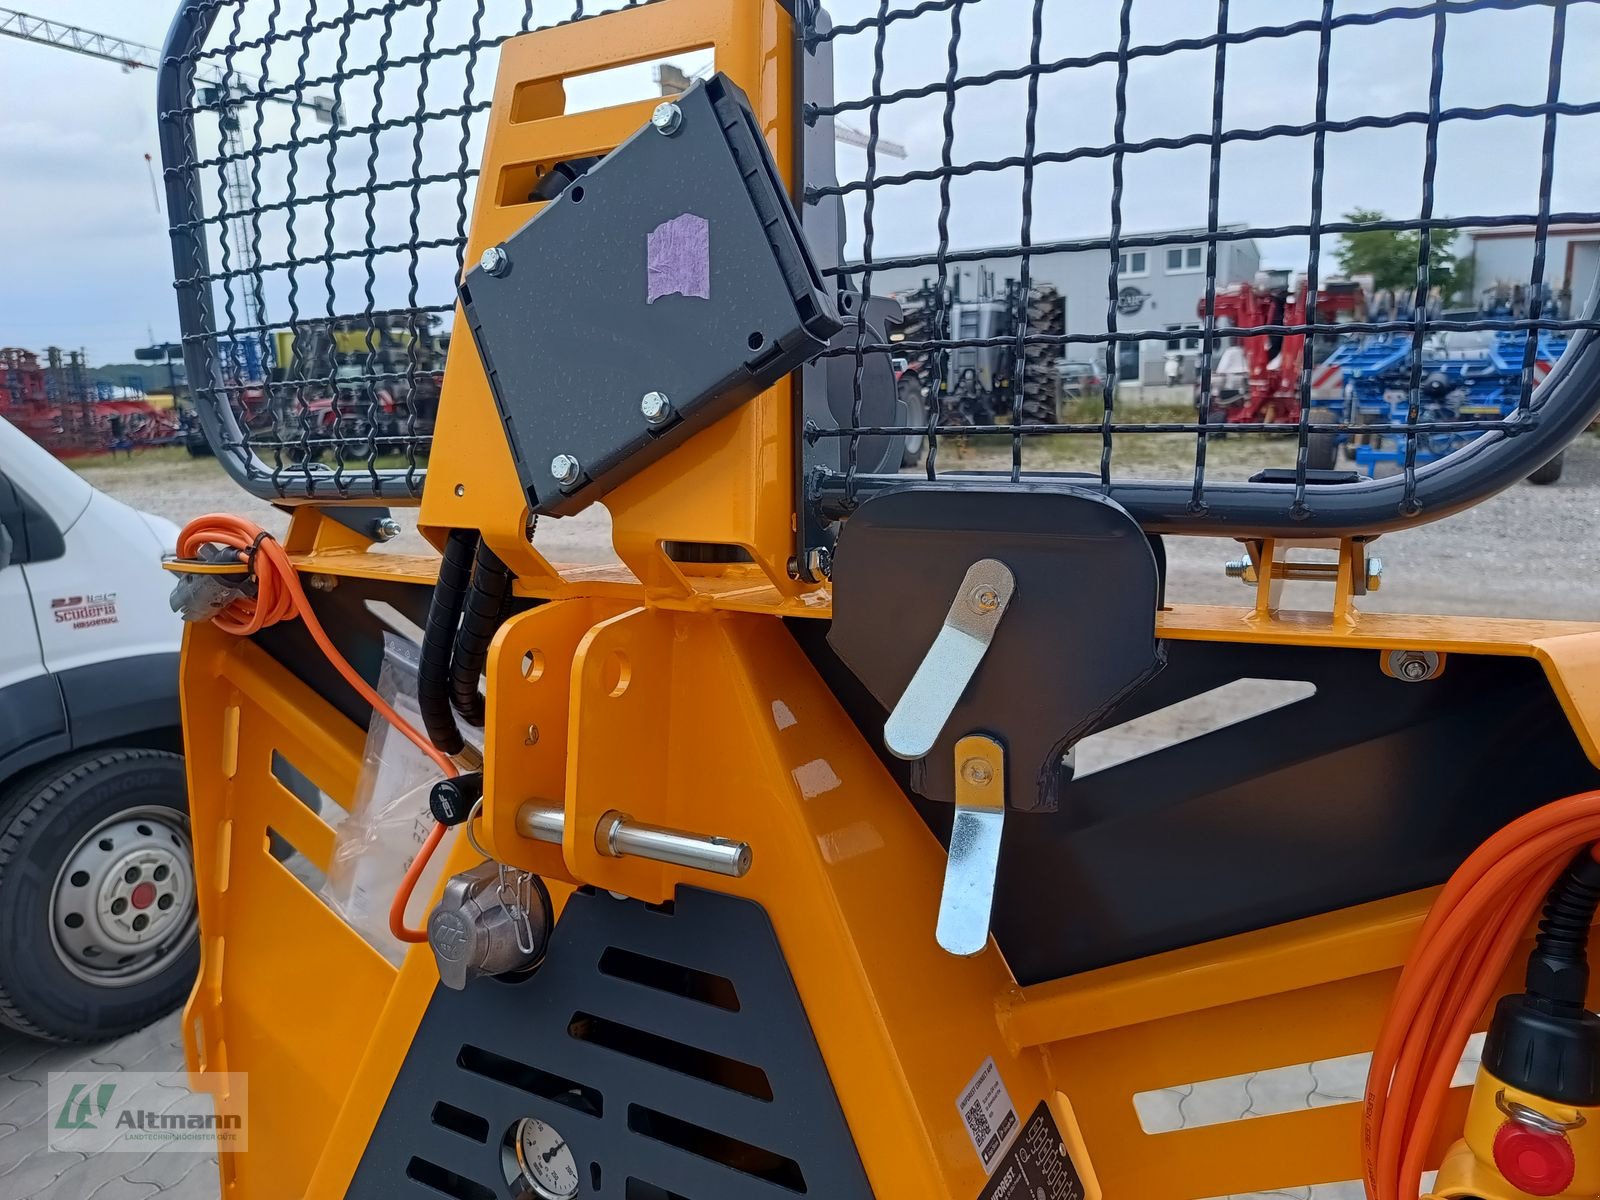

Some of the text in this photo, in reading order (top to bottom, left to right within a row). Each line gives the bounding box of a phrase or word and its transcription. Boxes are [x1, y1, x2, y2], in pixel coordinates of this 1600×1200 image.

[54, 604, 116, 623] Scuderia
[959, 1085, 977, 1111] UNIFOREST
[974, 1070, 988, 1090] CONNECT
[551, 1170, 560, 1181] 250
[565, 1164, 574, 1176] 200
